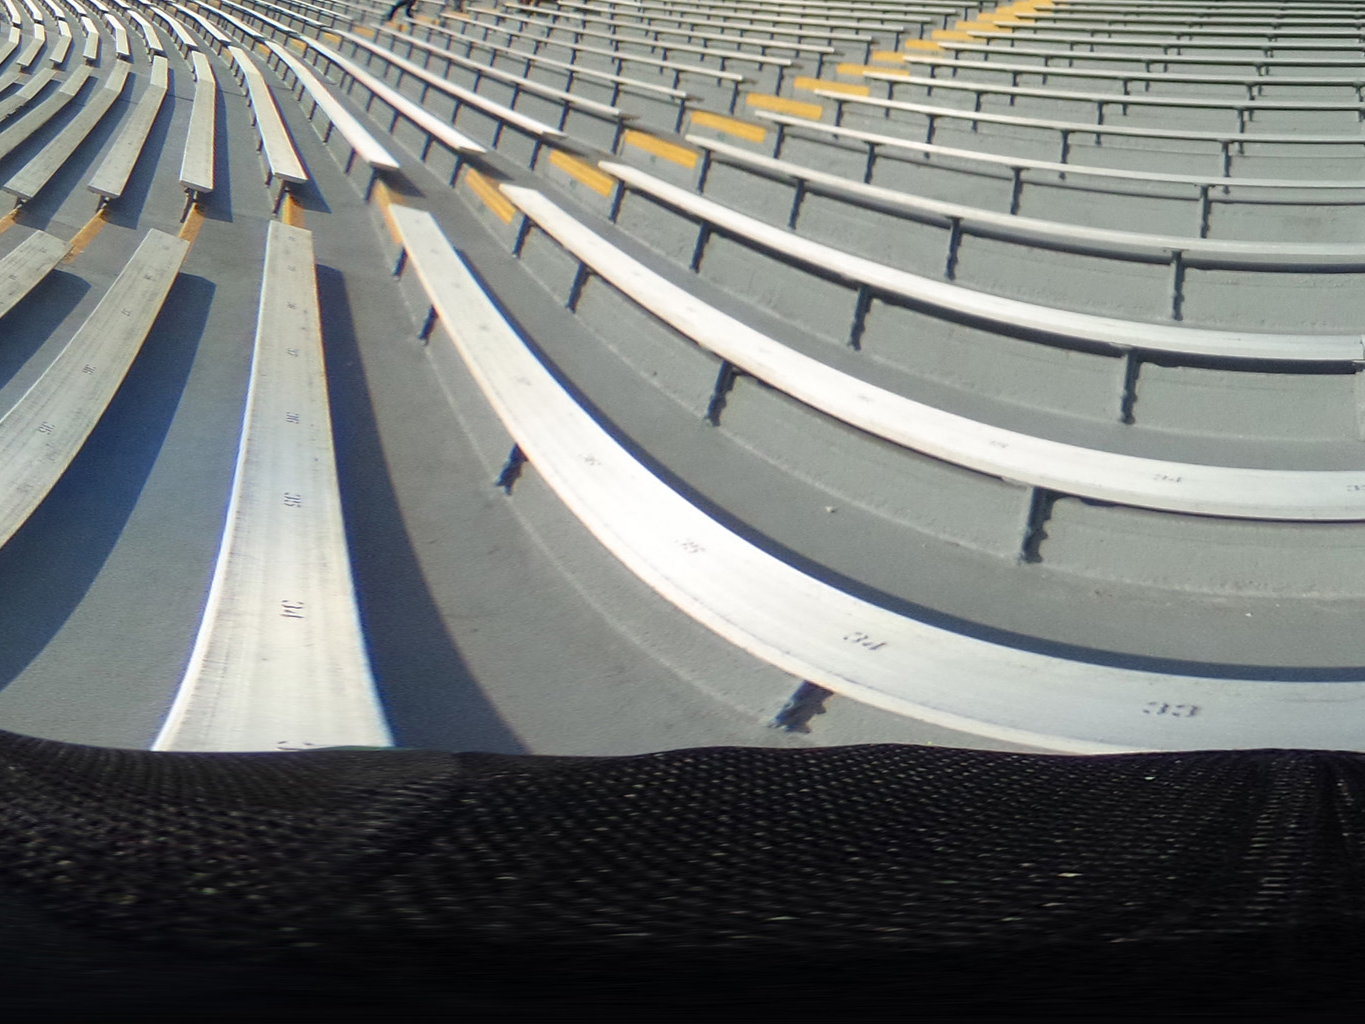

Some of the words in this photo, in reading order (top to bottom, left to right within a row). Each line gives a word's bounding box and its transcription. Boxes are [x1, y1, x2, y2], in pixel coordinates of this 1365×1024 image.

[36, 421, 55, 436] 35
[1153, 473, 1183, 484] 34
[283, 492, 301, 508] 35
[281, 599, 304, 619] 34
[842, 631, 888, 651] 34
[1142, 701, 1201, 718] 33
